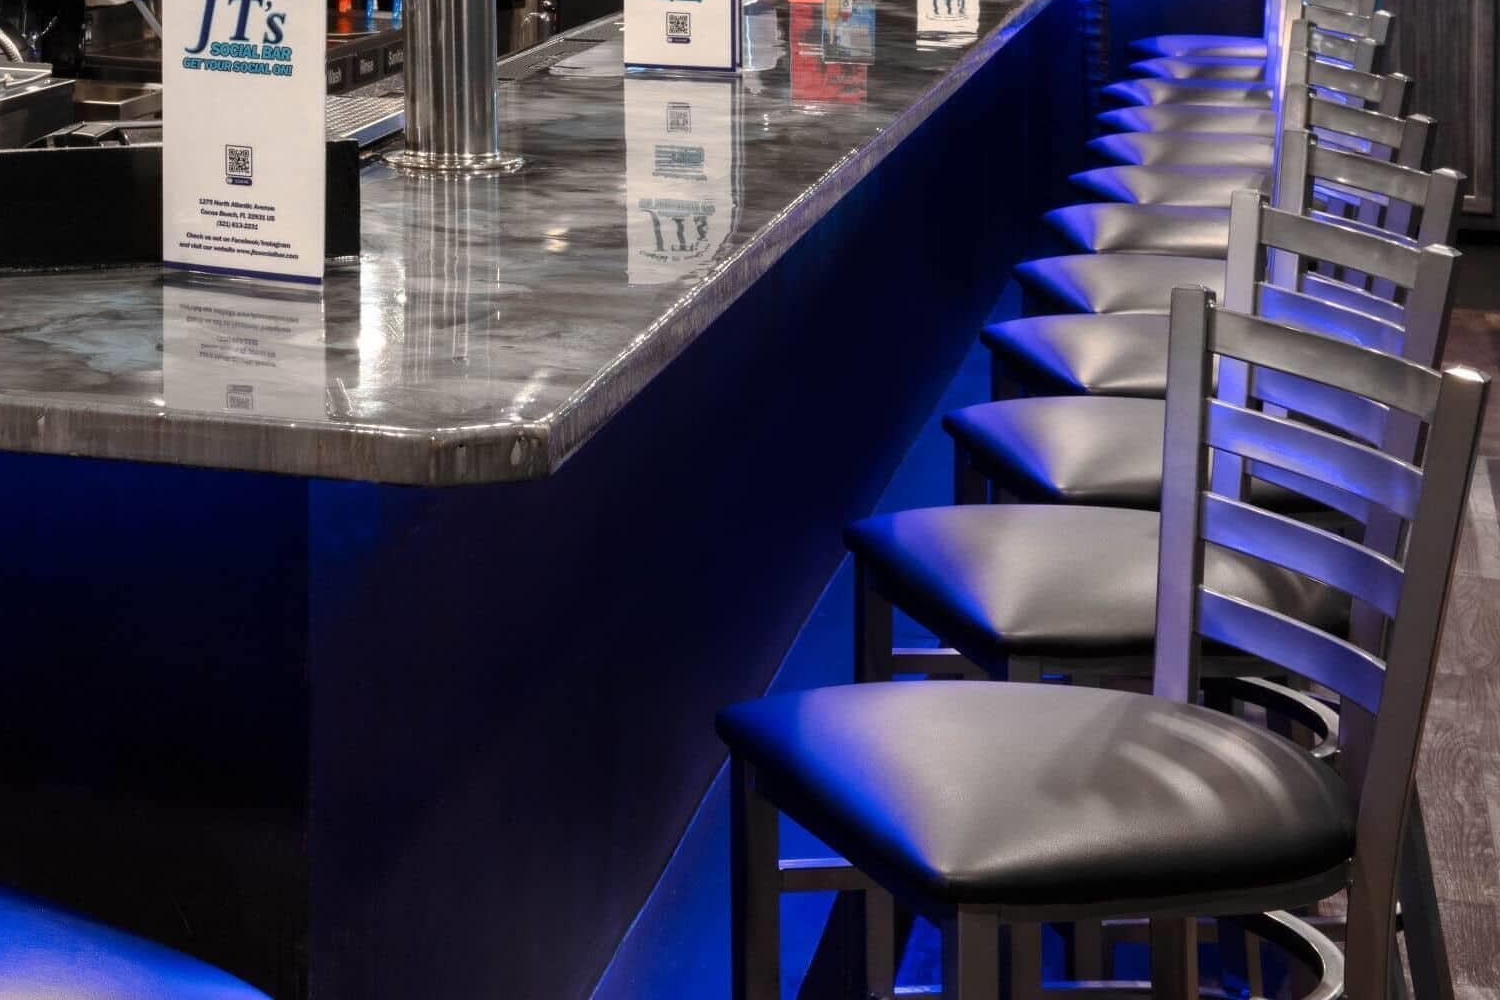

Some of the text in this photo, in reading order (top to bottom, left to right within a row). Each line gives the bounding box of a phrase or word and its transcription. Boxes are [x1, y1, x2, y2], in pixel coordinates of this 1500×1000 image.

[210, 41, 293, 63] SOCIAL BAR
[182, 56, 204, 70] GET
[204, 58, 232, 73] YOUR
[232, 60, 272, 75] SOCIAL
[200, 208, 218, 217] Cocoa
[214, 199, 230, 207] North
[230, 201, 252, 210] Atlantic
[253, 203, 276, 212] Avenue
